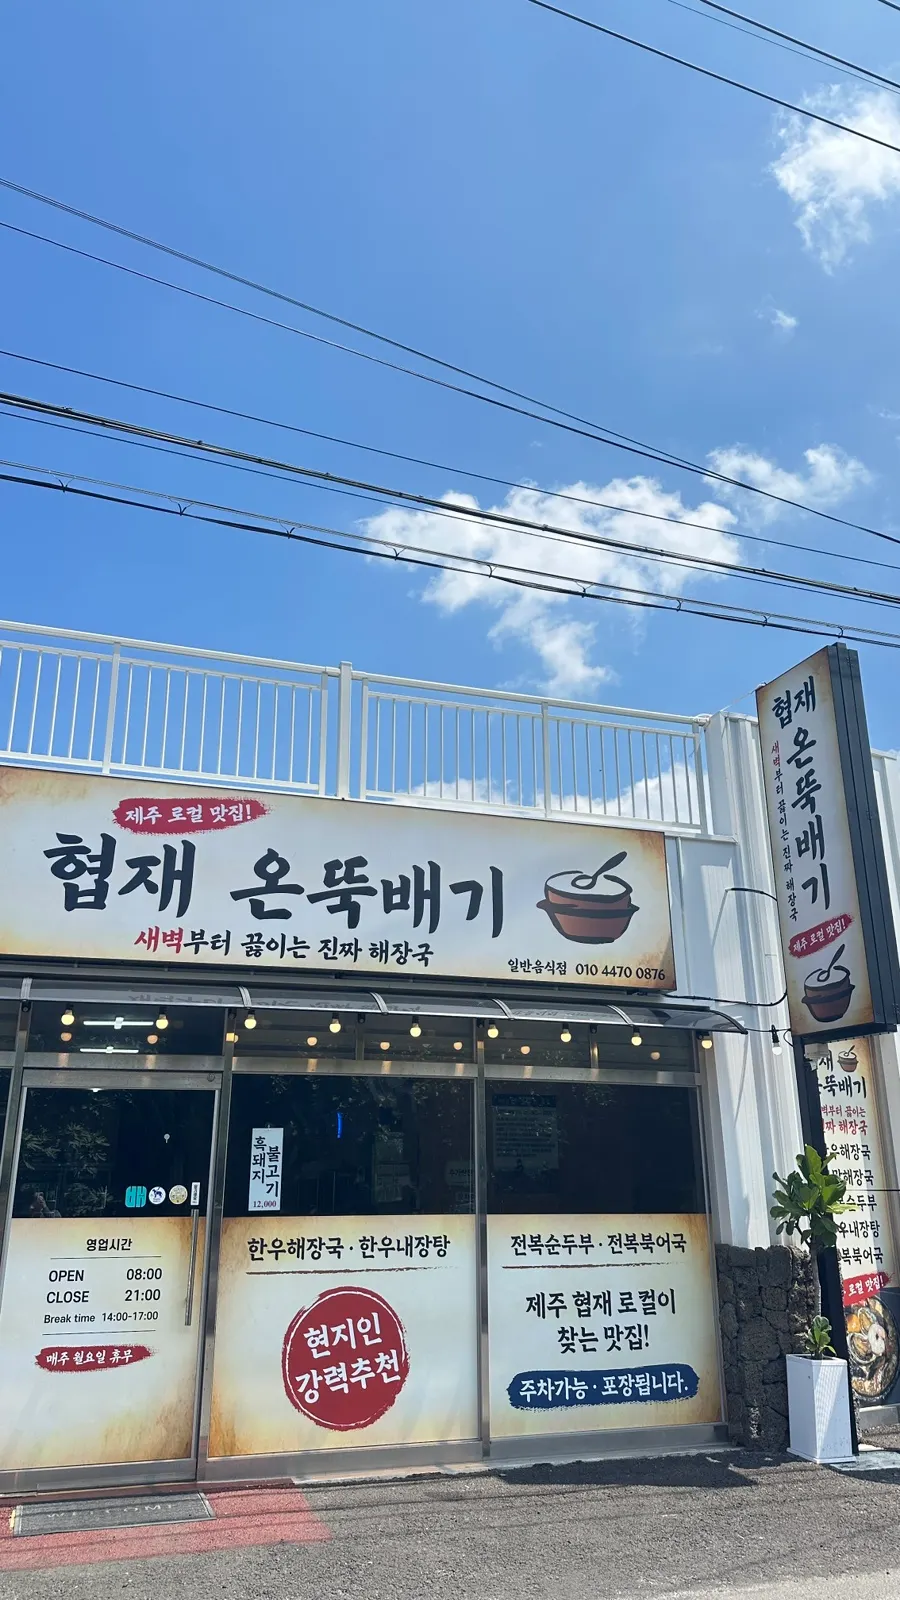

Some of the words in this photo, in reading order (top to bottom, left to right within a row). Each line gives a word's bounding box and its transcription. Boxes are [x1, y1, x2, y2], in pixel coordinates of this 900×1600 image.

[771, 675, 817, 729] 협재
[771, 740, 784, 795] 새벽부터
[125, 809, 162, 824] 제주
[168, 805, 203, 823] 로컬
[209, 803, 252, 822] 맛집!
[777, 799, 790, 841] 끓이는
[786, 727, 831, 911] 온뚝배기
[782, 845, 794, 874] 진짜
[43, 832, 197, 918] 협재
[229, 848, 504, 938] 온뚝배기
[786, 877, 799, 922] 해장국
[810, 928, 825, 946] 로컬
[826, 918, 846, 938] 맛집!
[134, 926, 231, 957] 새벽부터
[240, 932, 311, 959] 끓이는
[318, 937, 363, 962] 진짜
[369, 940, 434, 967] 해장국
[507, 958, 567, 976] 일반음식점
[575, 962, 598, 976] 010
[601, 963, 632, 978] 4470
[635, 966, 665, 981] 0876
[818, 1074, 867, 1098] 뚝배기
[821, 1105, 843, 1118] 벽부터
[844, 1105, 866, 1118] 끓이는
[838, 1119, 868, 1136] 해장국
[252, 1135, 266, 1184] 흑돼지
[826, 1144, 871, 1160] 우해장국
[265, 1145, 281, 1197] 불고기
[252, 1200, 277, 1208] 12,000
[838, 1220, 880, 1239] 우내장탕
[86, 1238, 133, 1252] 영업시간
[840, 1246, 884, 1265] 복북어국
[48, 1269, 85, 1282] OPEN
[126, 1267, 163, 1281] 08:00
[849, 1280, 864, 1296] 로컬
[865, 1275, 884, 1292] 맛집!
[46, 1290, 90, 1304] CLOSE
[125, 1289, 161, 1302] 21:00
[525, 1292, 567, 1319] 제주
[572, 1290, 611, 1318] 협재
[617, 1288, 676, 1316] 로컬이
[43, 1314, 72, 1324] Break
[74, 1313, 96, 1323] time
[102, 1311, 159, 1322] 14:00-17:00
[304, 1312, 381, 1359] 현지인
[557, 1326, 599, 1354] 찾는
[603, 1323, 650, 1352] 맛집!
[46, 1352, 70, 1366] 매주
[72, 1350, 105, 1365] 월요일
[109, 1349, 133, 1364] 휴무
[296, 1349, 401, 1404] 강력추천
